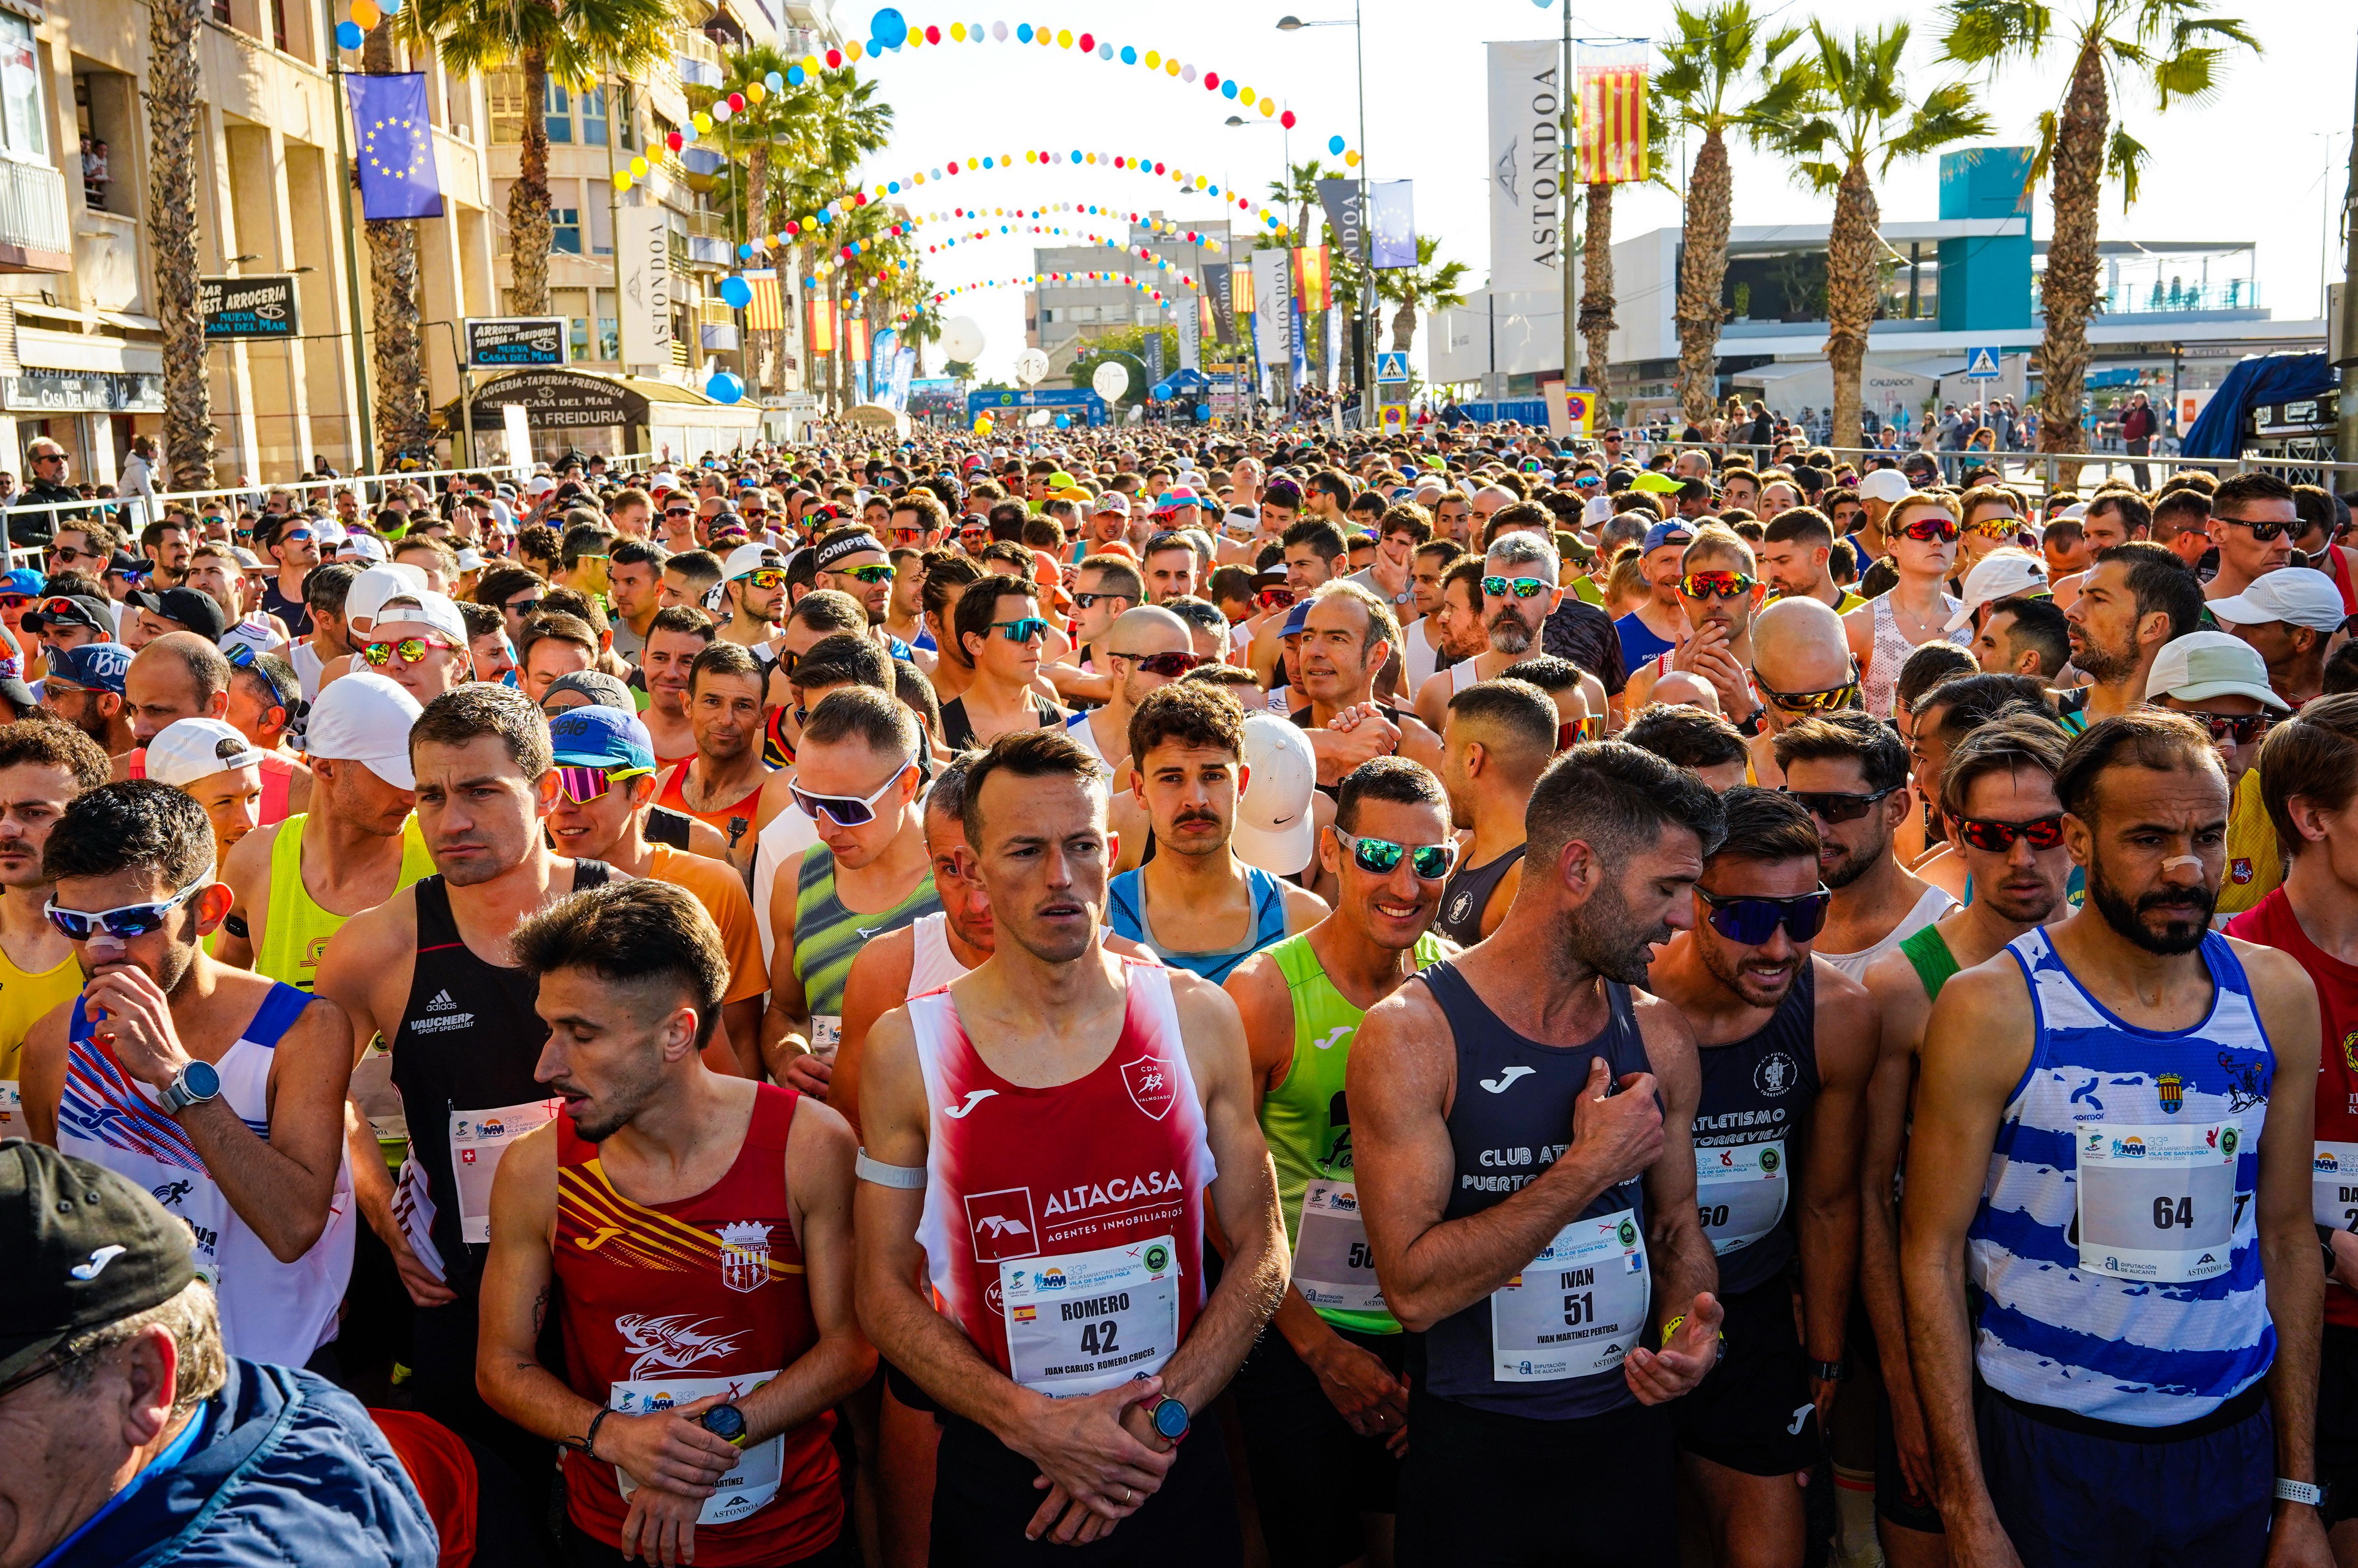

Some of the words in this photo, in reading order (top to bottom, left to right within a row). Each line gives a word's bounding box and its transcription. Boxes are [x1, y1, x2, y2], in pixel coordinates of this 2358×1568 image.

[1533, 65, 1557, 271] ASTONDOA
[1342, 194, 1360, 263] NDOA
[649, 223, 669, 351] ASTONDOA
[203, 297, 223, 314] EST.
[226, 285, 286, 310] ARROCERIA
[1275, 261, 1290, 353] ASTONDOA
[220, 313, 256, 322] NUEVA
[475, 325, 520, 337] ARROCERIA
[476, 335, 508, 348] TAPERIA
[515, 327, 556, 342] FREIDURIA
[2191, 348, 2231, 357] AZTECA
[61, 380, 82, 391] NUEVA
[1870, 377, 1914, 387] CALZADOS
[545, 410, 626, 425] FREIDURIA
[426, 1002, 457, 1011] adidas
[411, 1013, 465, 1030] VAUCHER
[439, 1022, 474, 1031] SPECIALIST
[1771, 1052, 1791, 1060] PUERTO
[1761, 1087, 1790, 1097] TORREVIEJA
[1479, 1147, 1532, 1167] CLUB
[1044, 1169, 1183, 1217] ALTACASA
[1698, 1205, 1729, 1227] 60
[2153, 1196, 2193, 1229] 64
[1048, 1225, 1097, 1243] AGENTES
[1103, 1207, 1182, 1230] INMOBILIARIOS
[1092, 1274, 1113, 1283] SANTA
[1561, 1267, 1594, 1290] IVAN
[2187, 1264, 2222, 1277] ASTONDOA
[1061, 1292, 1130, 1321] ROMERO
[1564, 1291, 1593, 1326] 51
[1080, 1320, 1119, 1356] 42
[1556, 1329, 1589, 1342] MARTINEZ
[1591, 1323, 1619, 1337] PERTUSA
[1045, 1367, 1063, 1375] JUAN
[1065, 1363, 1094, 1374] CARLOS
[1097, 1356, 1128, 1370] ROMERO
[1129, 1347, 1155, 1362] CRUCES
[1592, 1352, 1627, 1368] ASTONDO
[713, 1503, 759, 1518] ASTONDOA
